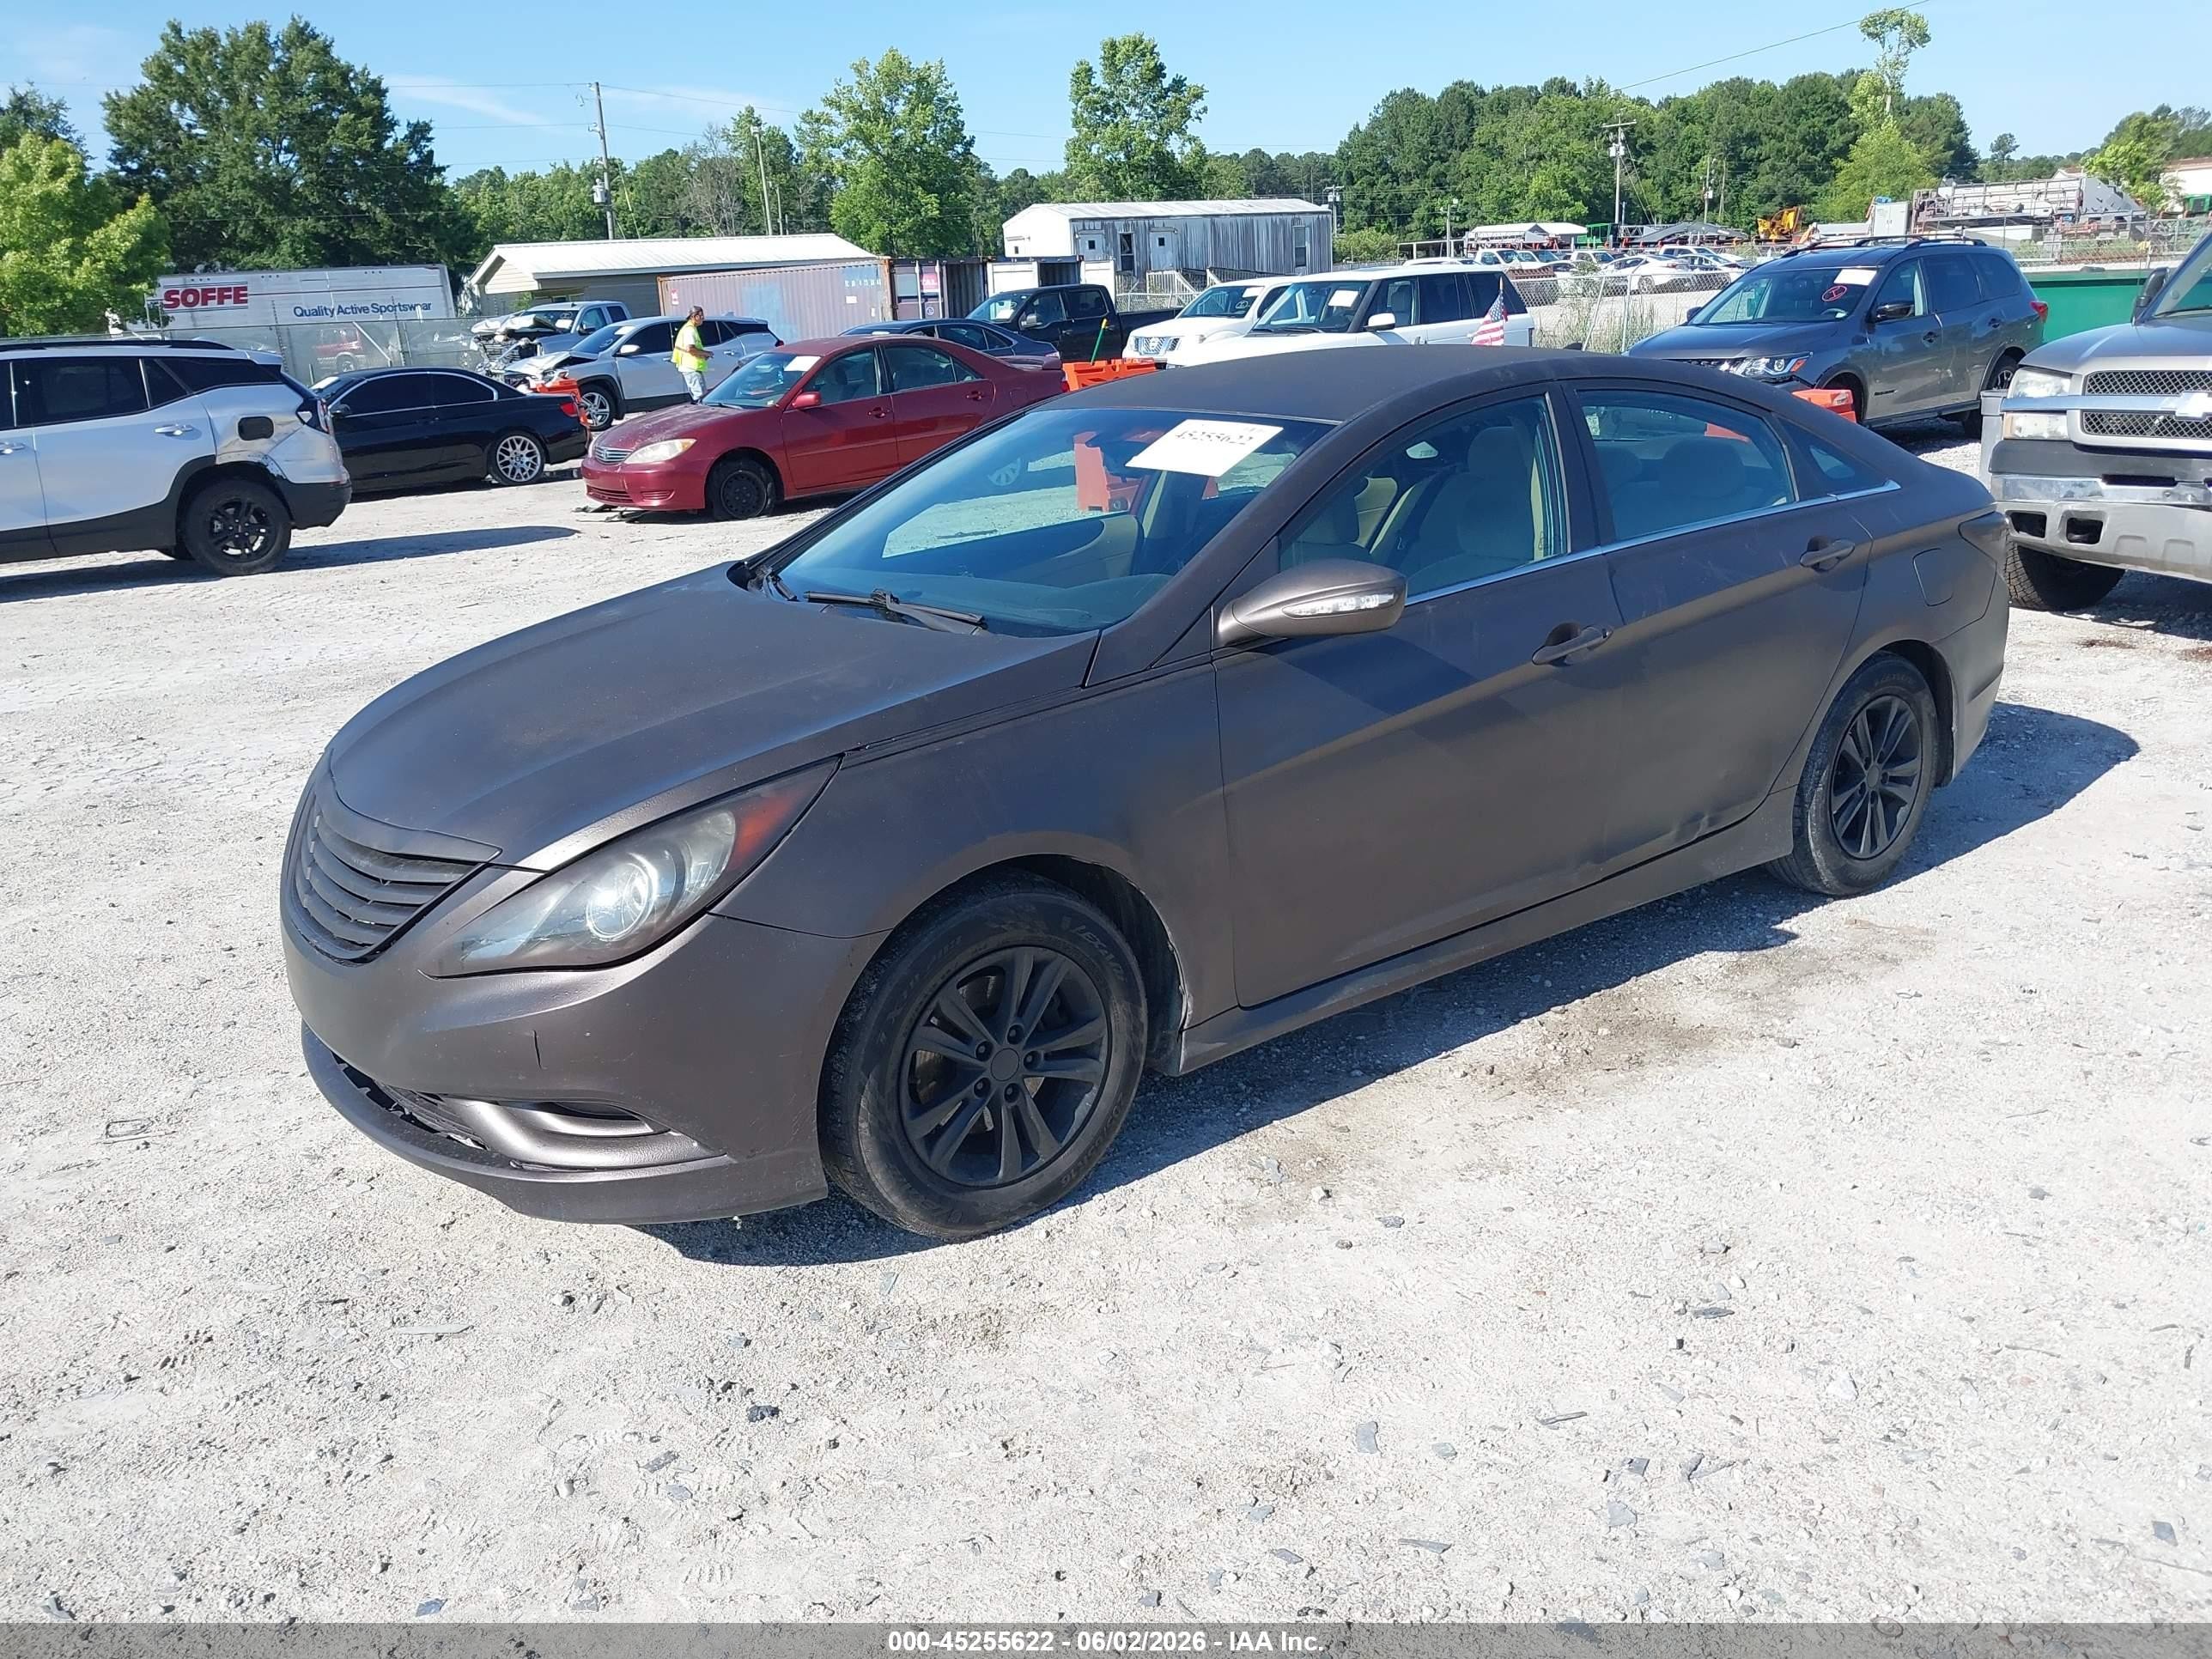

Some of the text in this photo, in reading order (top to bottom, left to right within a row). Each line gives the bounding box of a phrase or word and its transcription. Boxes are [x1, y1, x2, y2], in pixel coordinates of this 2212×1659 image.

[163, 286, 248, 308] SOFFE
[293, 306, 335, 318] Quality
[337, 304, 369, 315] Active
